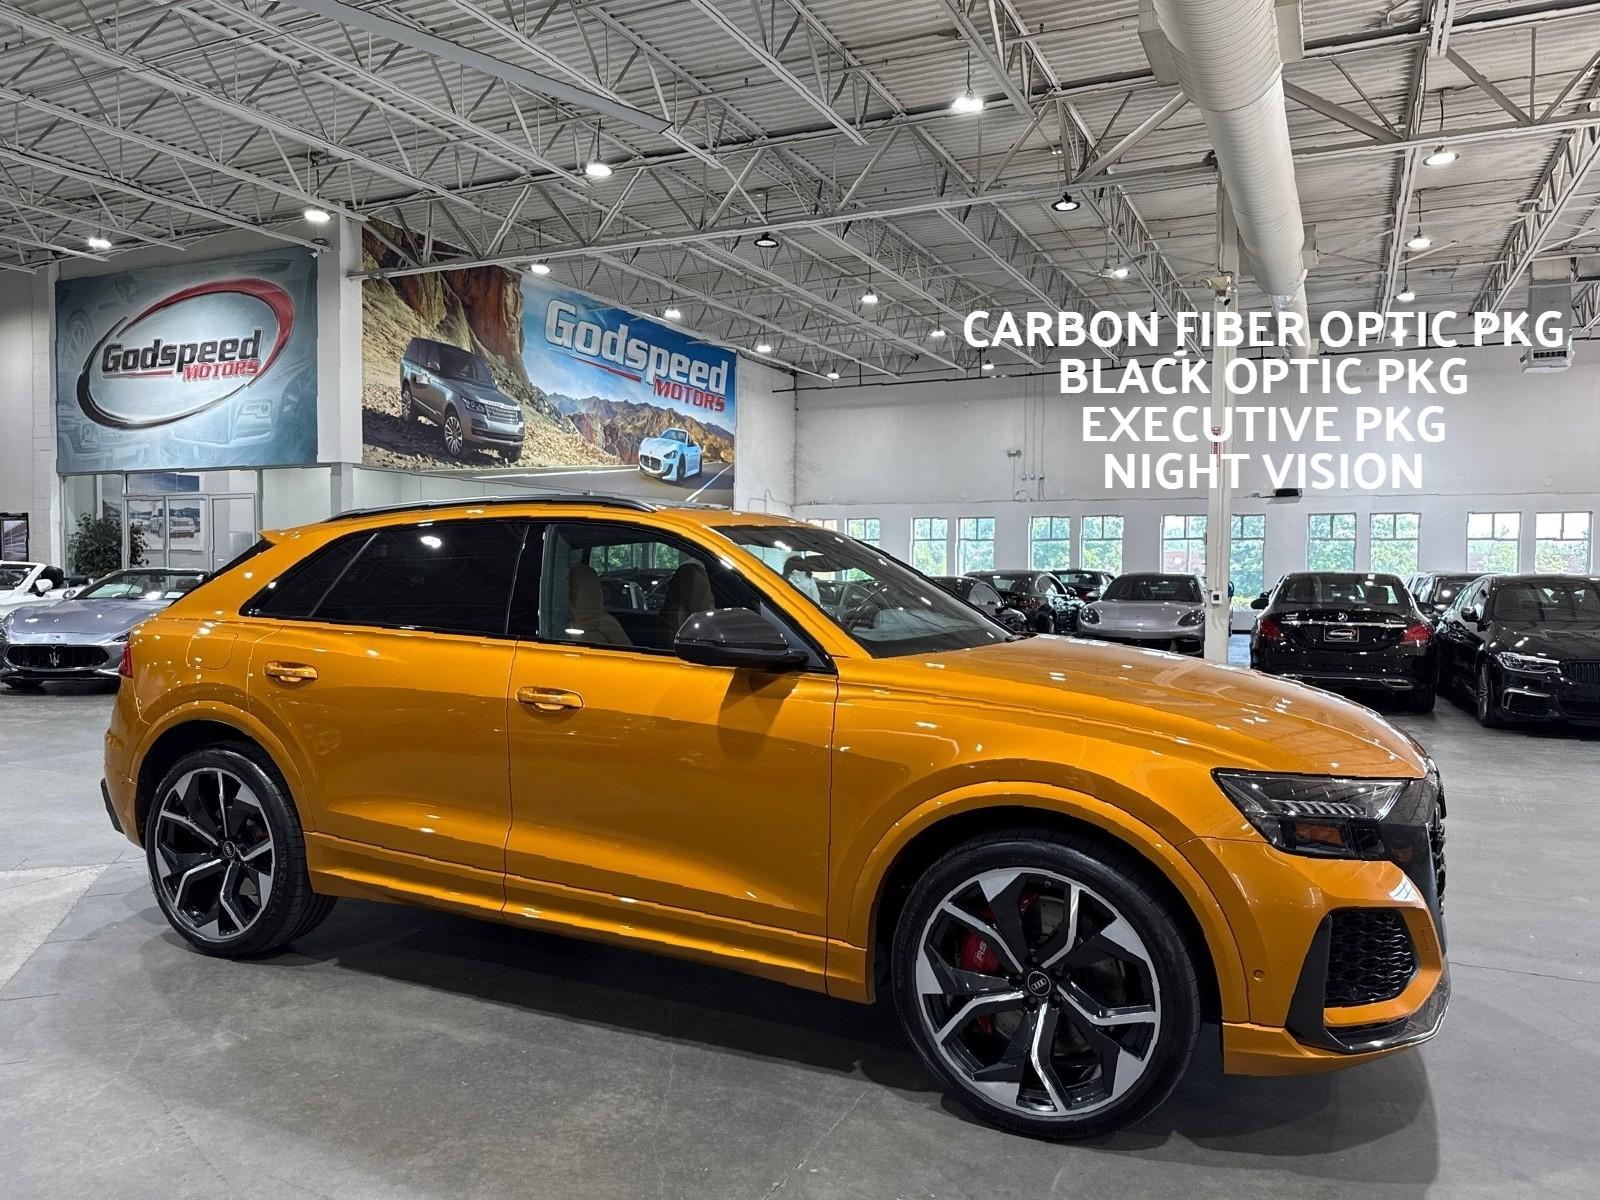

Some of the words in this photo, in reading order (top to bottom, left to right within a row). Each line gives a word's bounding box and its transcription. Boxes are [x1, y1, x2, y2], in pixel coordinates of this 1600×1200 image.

[104, 329, 262, 373] Godspeed
[546, 299, 728, 395] Godspeed
[184, 359, 259, 382] MOTORS
[653, 378, 726, 412] MOTORS
[976, 940, 987, 962] RS
